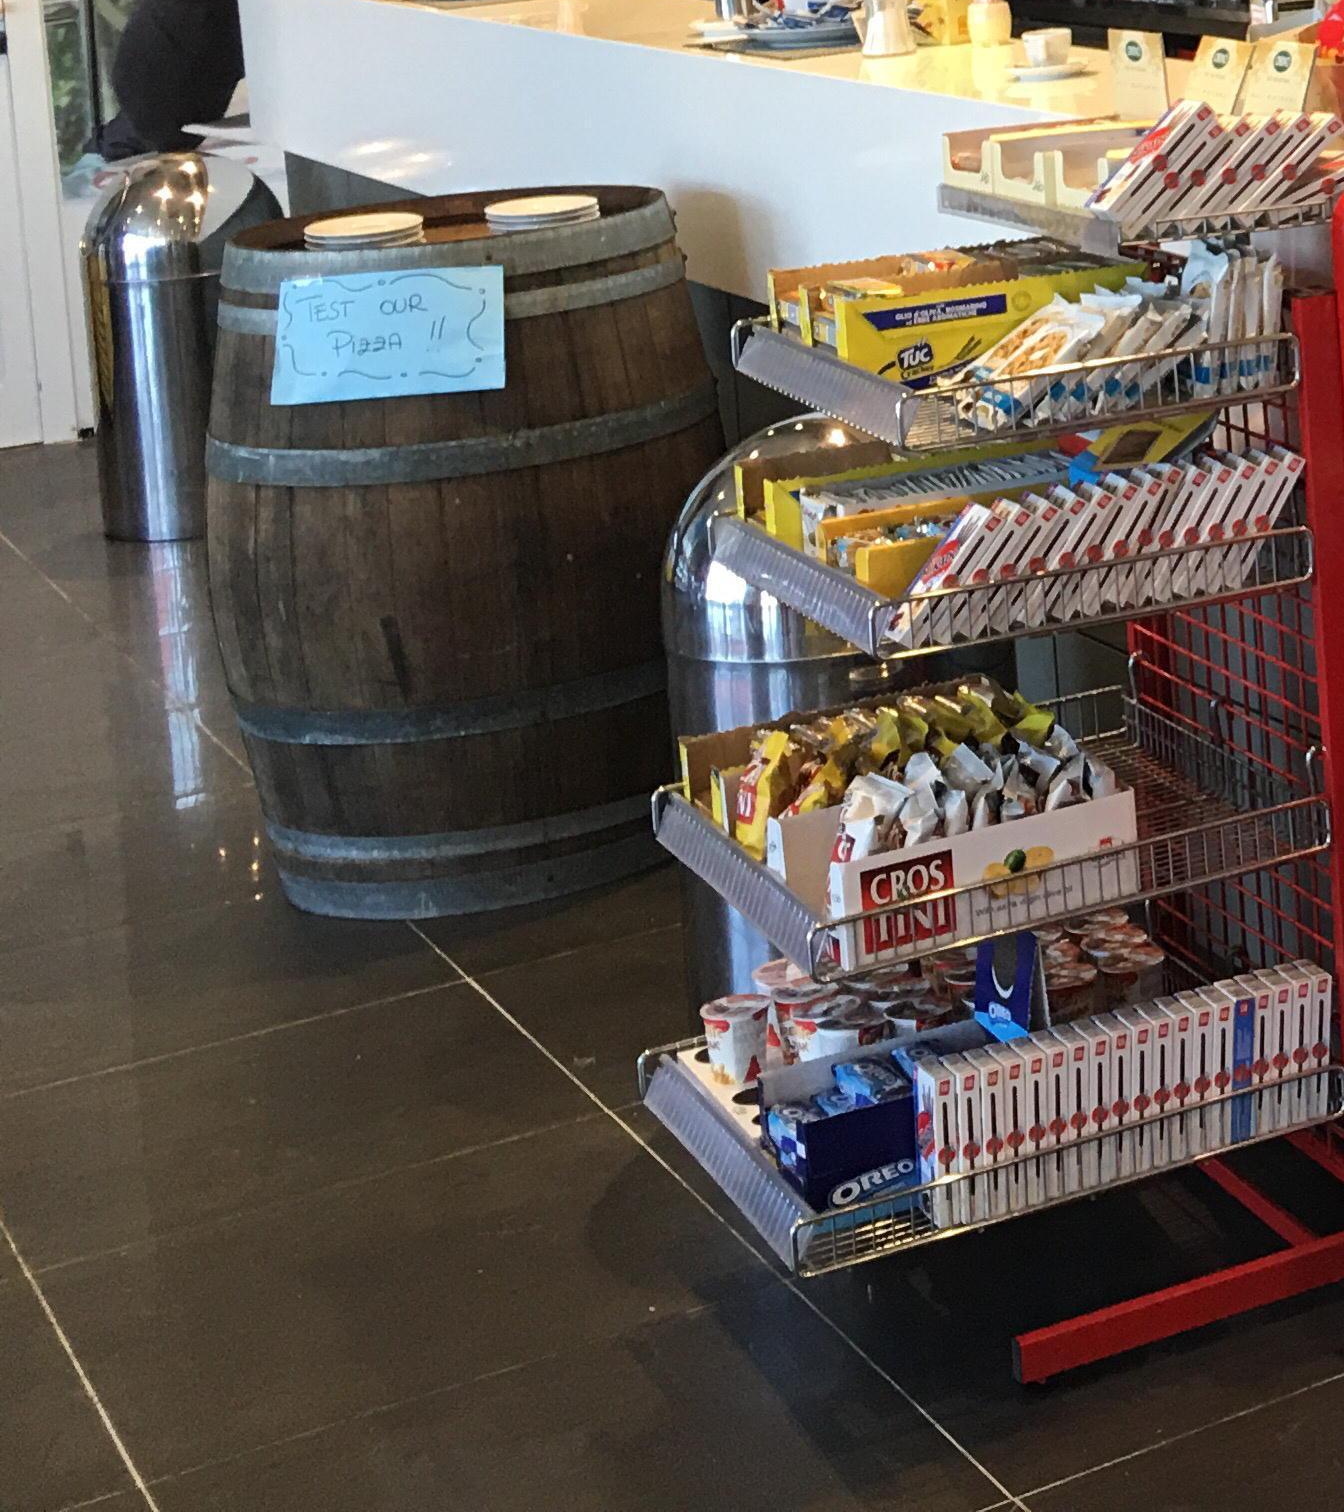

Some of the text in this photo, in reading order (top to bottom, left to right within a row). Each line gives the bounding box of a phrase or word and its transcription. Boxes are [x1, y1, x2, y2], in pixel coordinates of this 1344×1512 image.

[296, 293, 428, 323] TEST OUR
[327, 330, 402, 358] PIZZA
[900, 347, 932, 369] TUC
[870, 859, 945, 905] CROS
[830, 1157, 915, 1207] OREO
